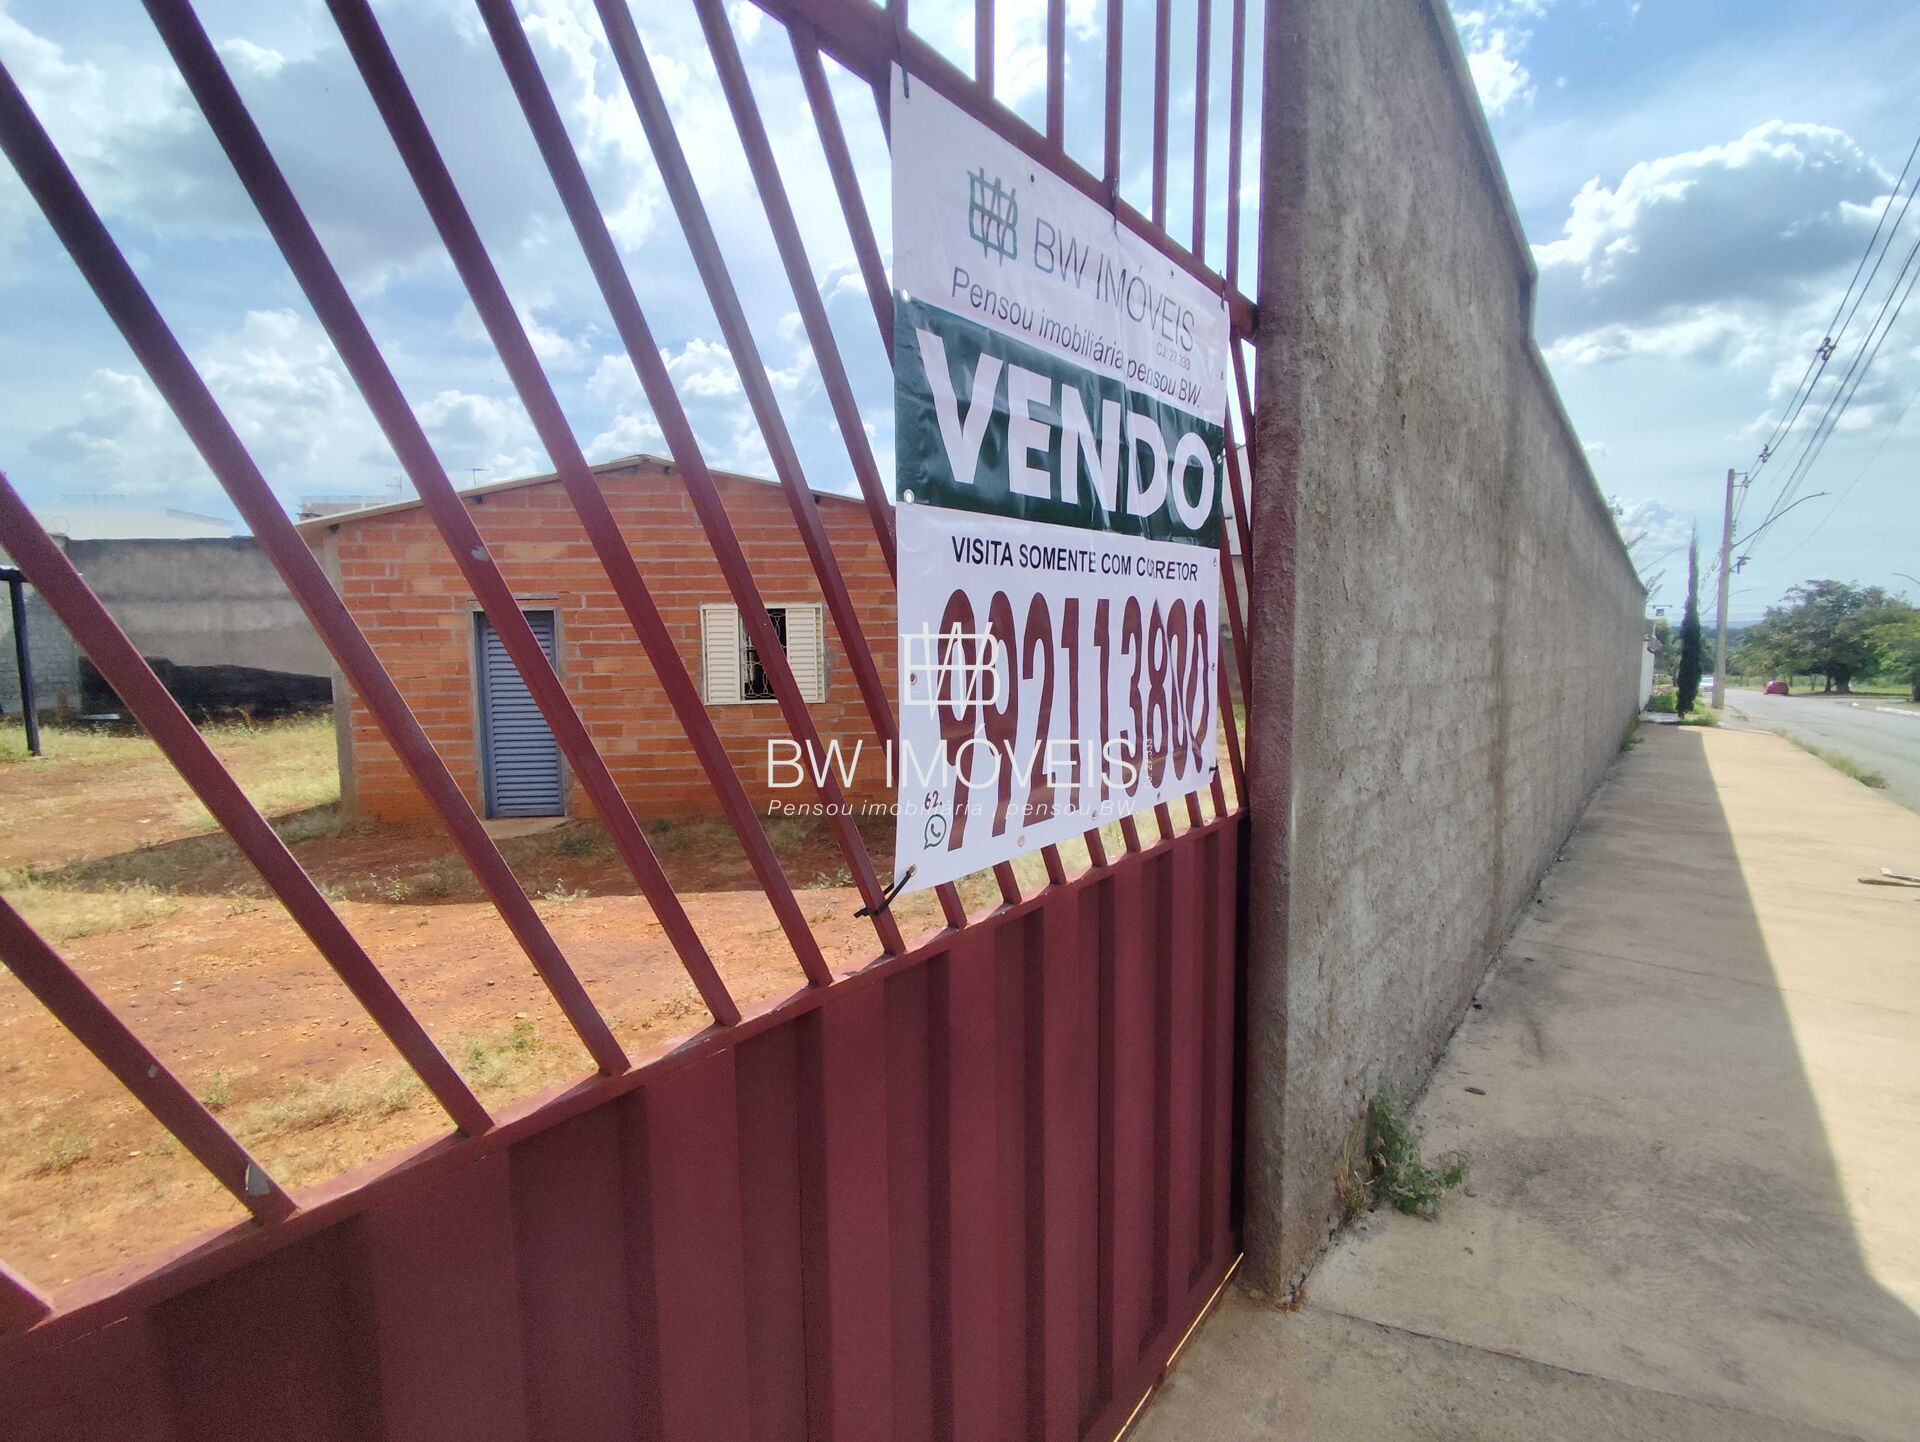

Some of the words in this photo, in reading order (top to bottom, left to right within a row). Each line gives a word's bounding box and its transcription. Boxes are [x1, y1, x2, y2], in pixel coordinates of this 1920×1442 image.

[952, 267, 1033, 332] Pensou
[1039, 309, 1124, 369] imobiliária
[1127, 357, 1176, 395] pensou
[1179, 377, 1202, 409] BW.
[1034, 217, 1089, 289] BW
[1096, 252, 1195, 352] IMÓVEIS
[915, 327, 1215, 530] VENDO
[951, 535, 1014, 568] VISITA
[1019, 543, 1097, 574] SOMENTE
[1101, 552, 1132, 576] COM
